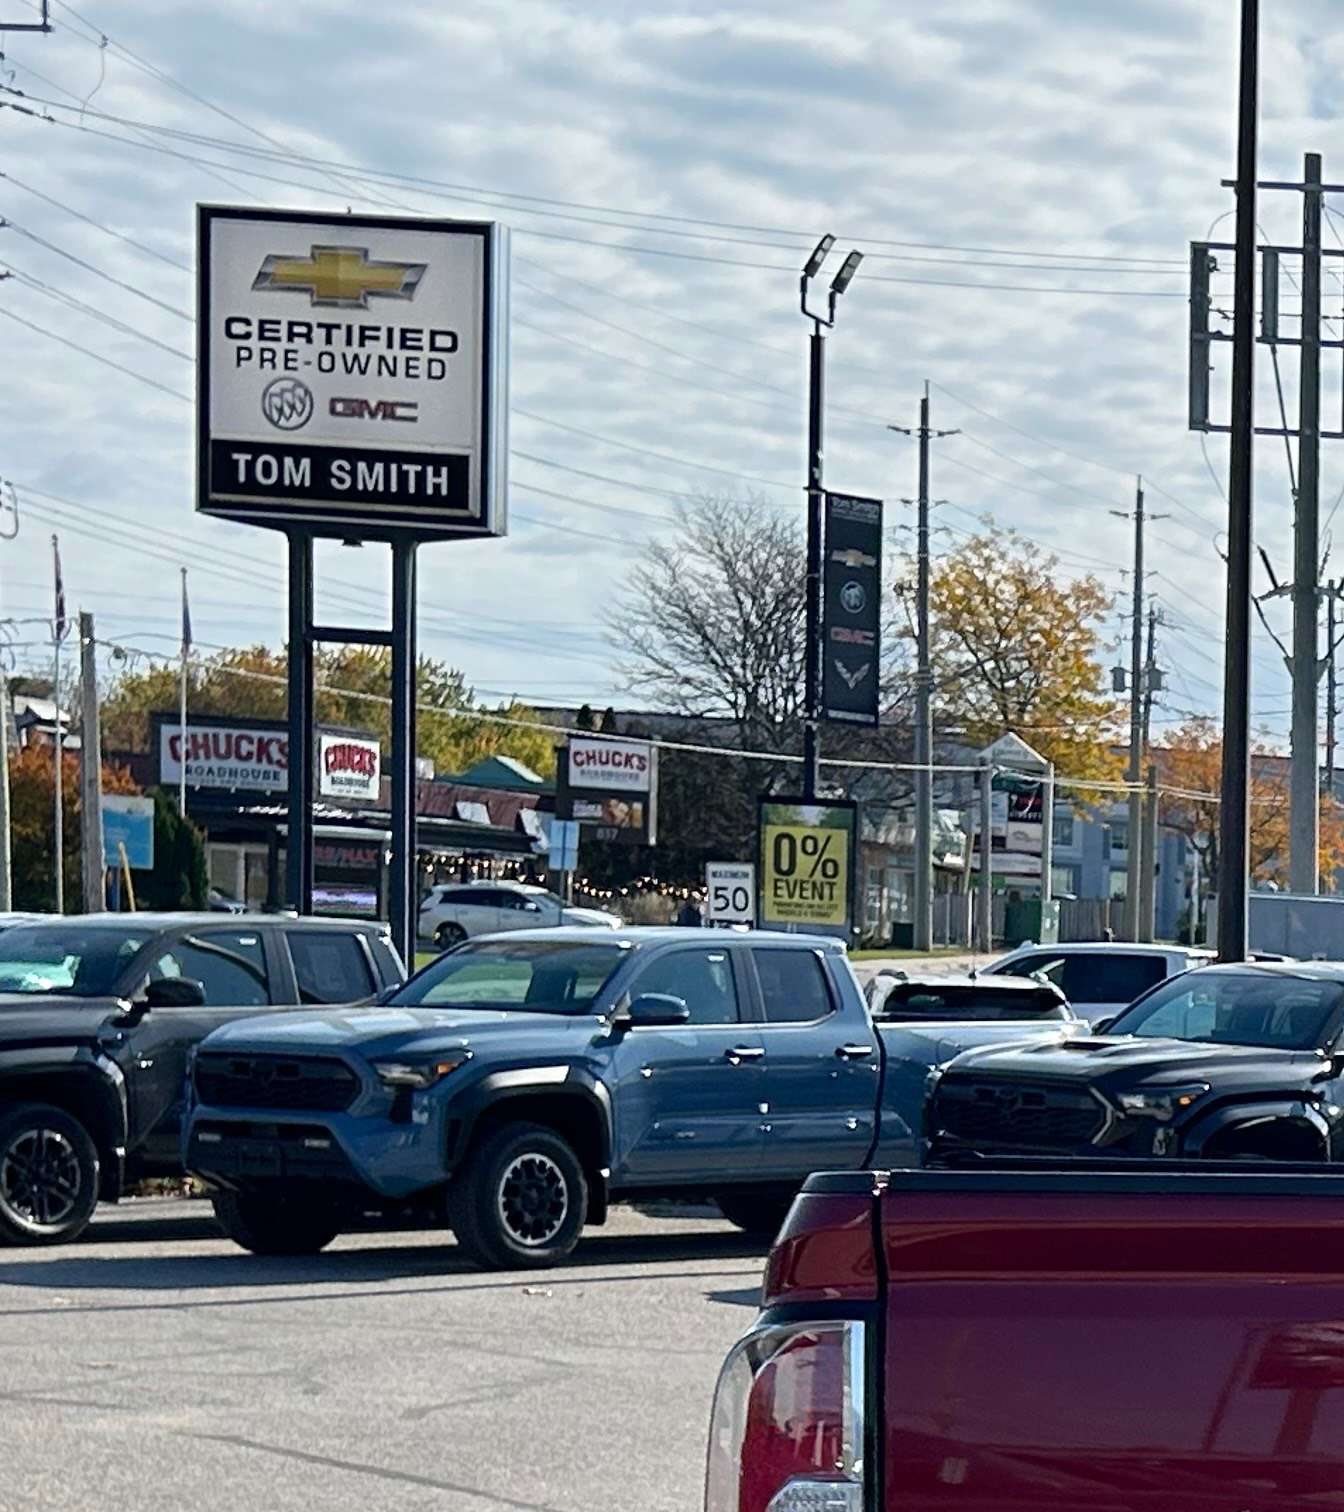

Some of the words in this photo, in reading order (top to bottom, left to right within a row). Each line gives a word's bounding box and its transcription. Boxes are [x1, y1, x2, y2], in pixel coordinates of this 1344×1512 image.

[225, 317, 458, 353] CERTIFIED
[236, 346, 446, 380] PRE-OWNED
[329, 397, 418, 423] GMC
[232, 453, 311, 487] TOM
[330, 459, 448, 496] SMITH
[773, 832, 839, 880] 0%
[714, 886, 749, 912] 50
[773, 878, 837, 901] EVENT
